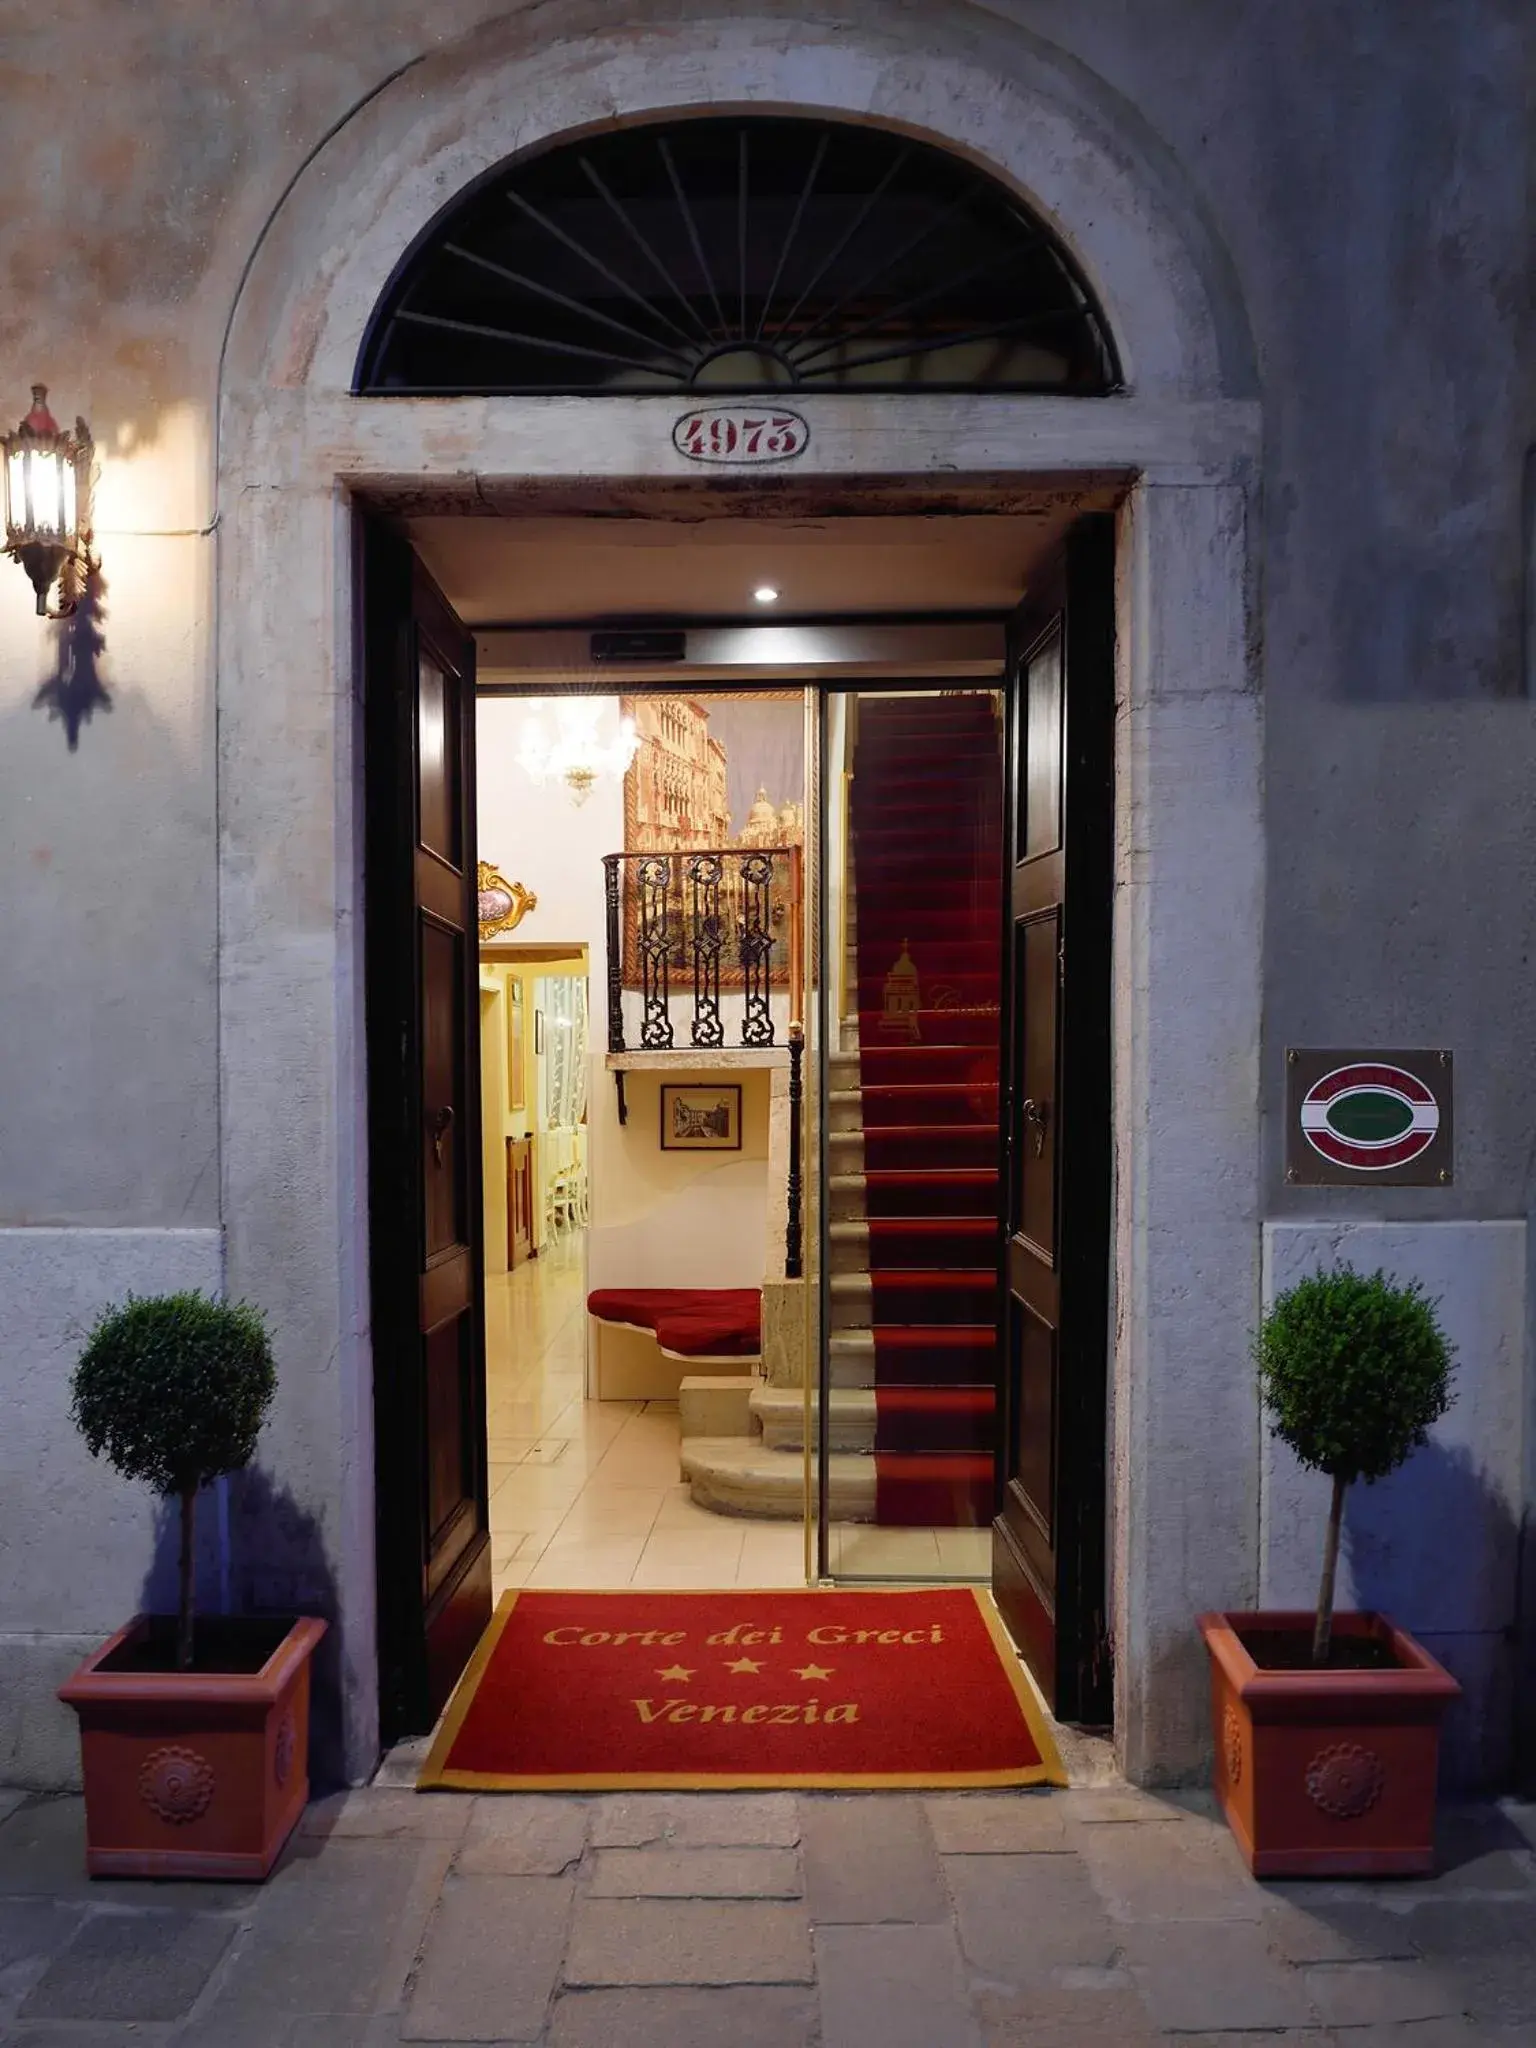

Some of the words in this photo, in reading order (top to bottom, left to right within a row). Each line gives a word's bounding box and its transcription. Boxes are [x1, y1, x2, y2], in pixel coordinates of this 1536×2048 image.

[679, 417, 797, 454] 4973
[542, 1626, 687, 1646] Corte
[706, 1623, 784, 1645] dei
[807, 1624, 945, 1645] Greci
[632, 1698, 860, 1725] Venezia
